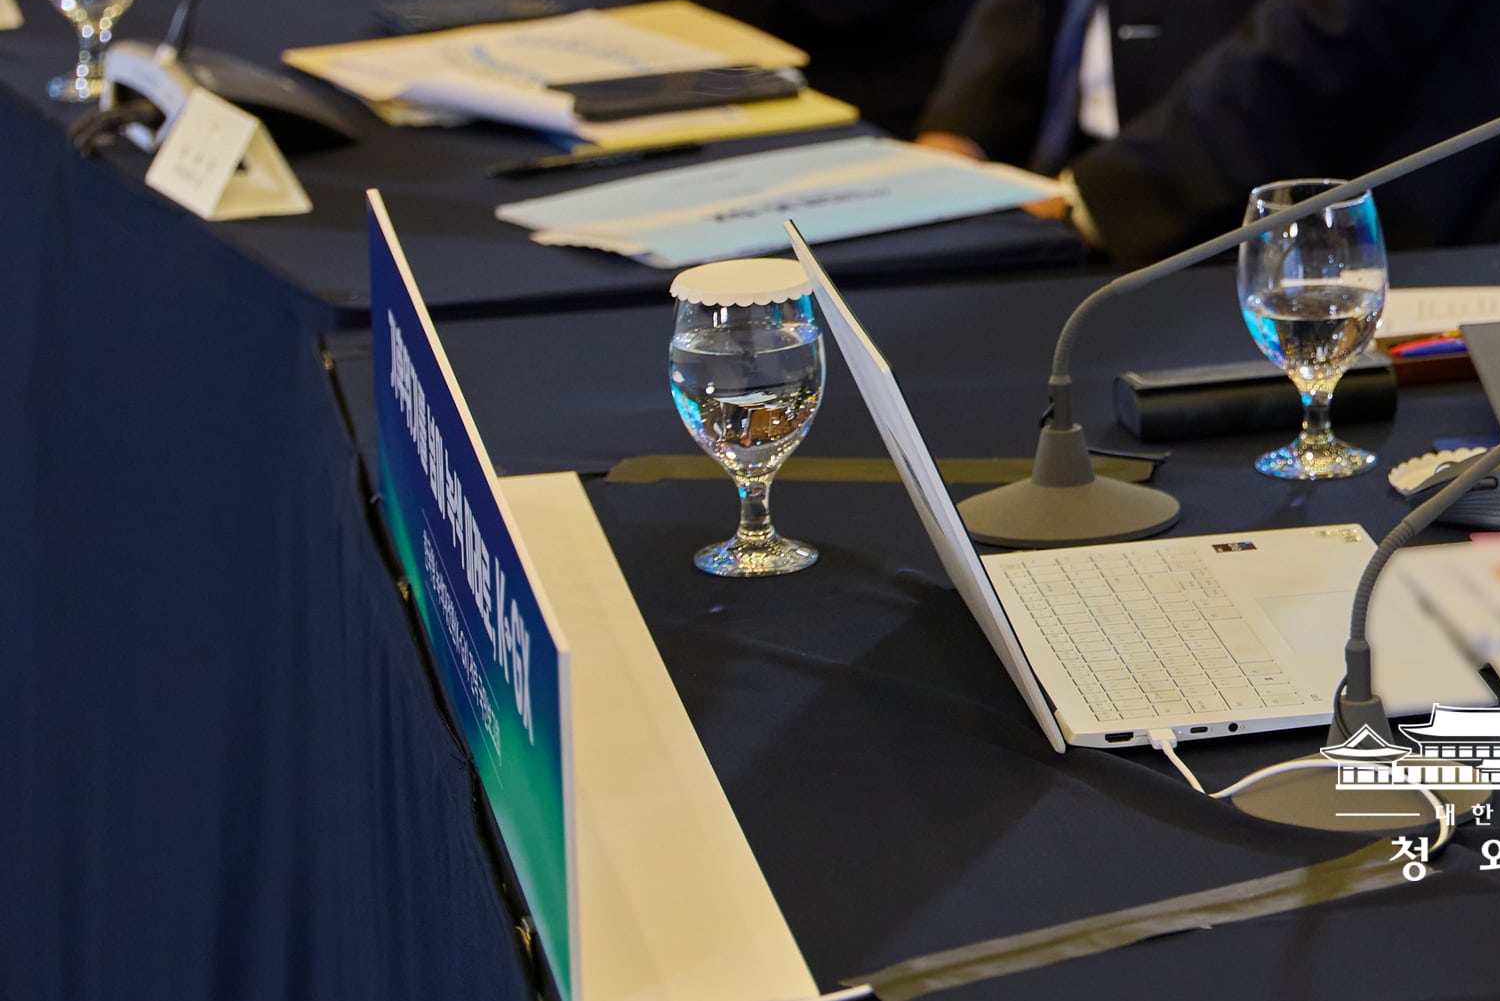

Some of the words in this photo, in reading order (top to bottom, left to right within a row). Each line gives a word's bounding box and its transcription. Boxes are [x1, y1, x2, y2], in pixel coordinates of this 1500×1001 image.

[387, 308, 429, 476] 기후위기를
[427, 404, 446, 520] 넘어
[445, 447, 465, 570] 녹색
